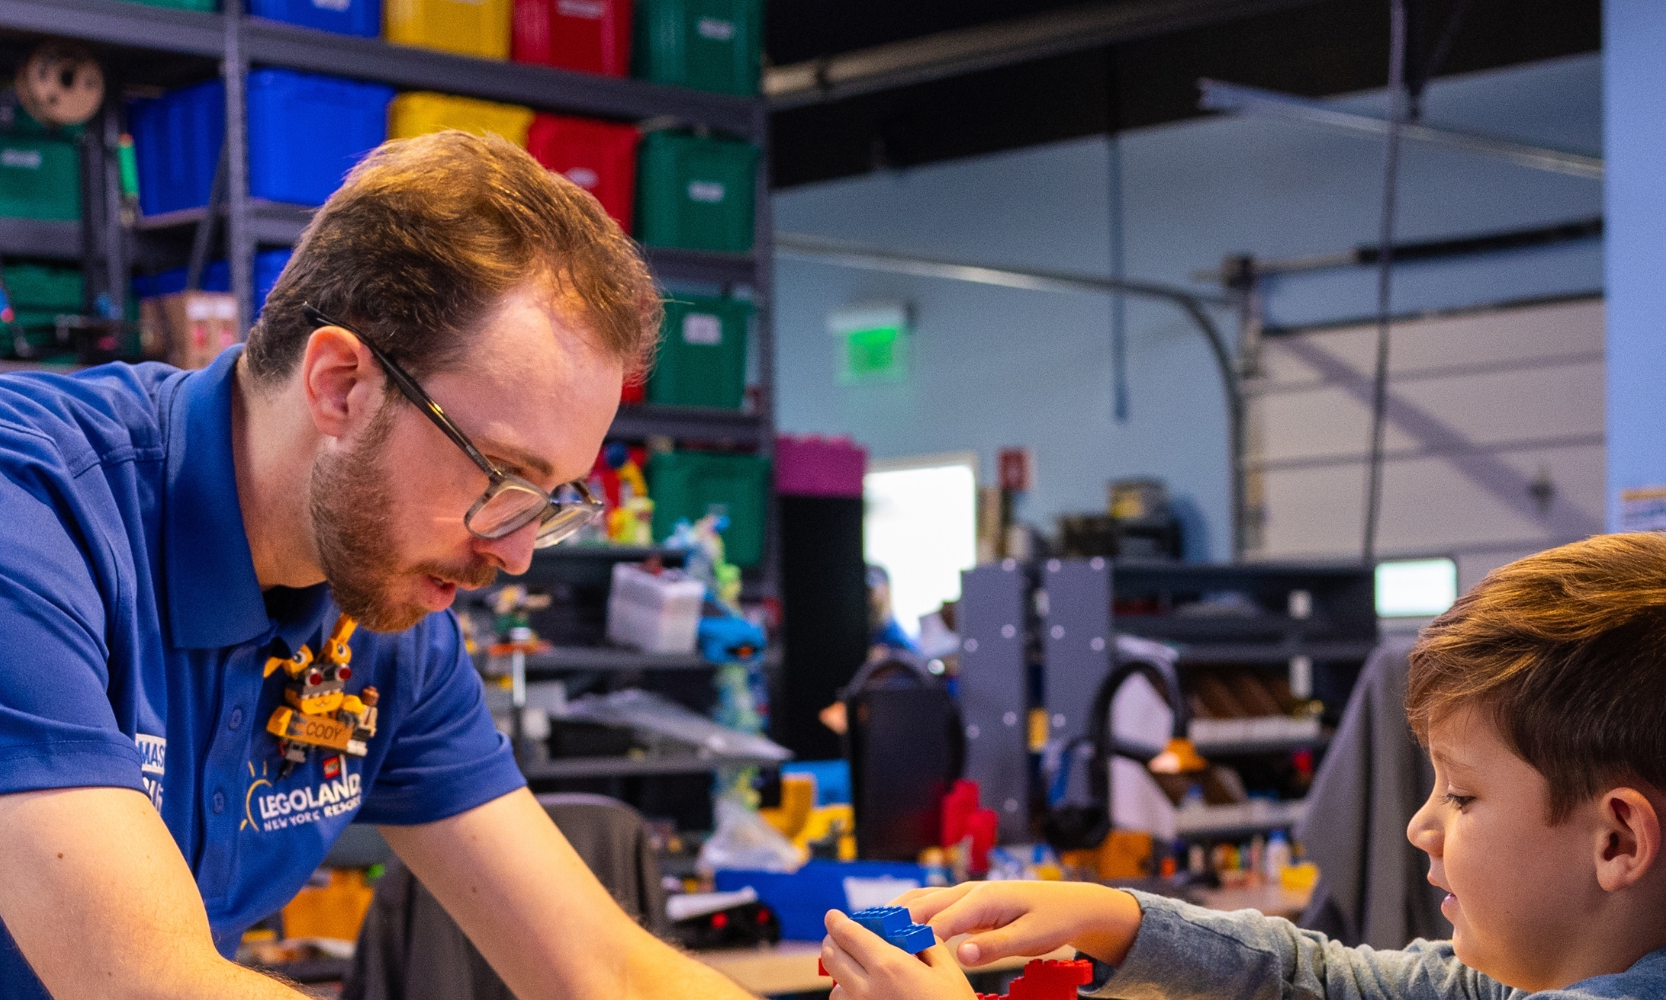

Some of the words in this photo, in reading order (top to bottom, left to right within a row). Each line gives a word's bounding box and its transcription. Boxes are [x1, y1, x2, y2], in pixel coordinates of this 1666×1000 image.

[306, 721, 342, 740] CODY
[258, 763, 362, 819] LEGOLAND
[263, 817, 288, 832] NEW
[289, 809, 321, 826] YORK
